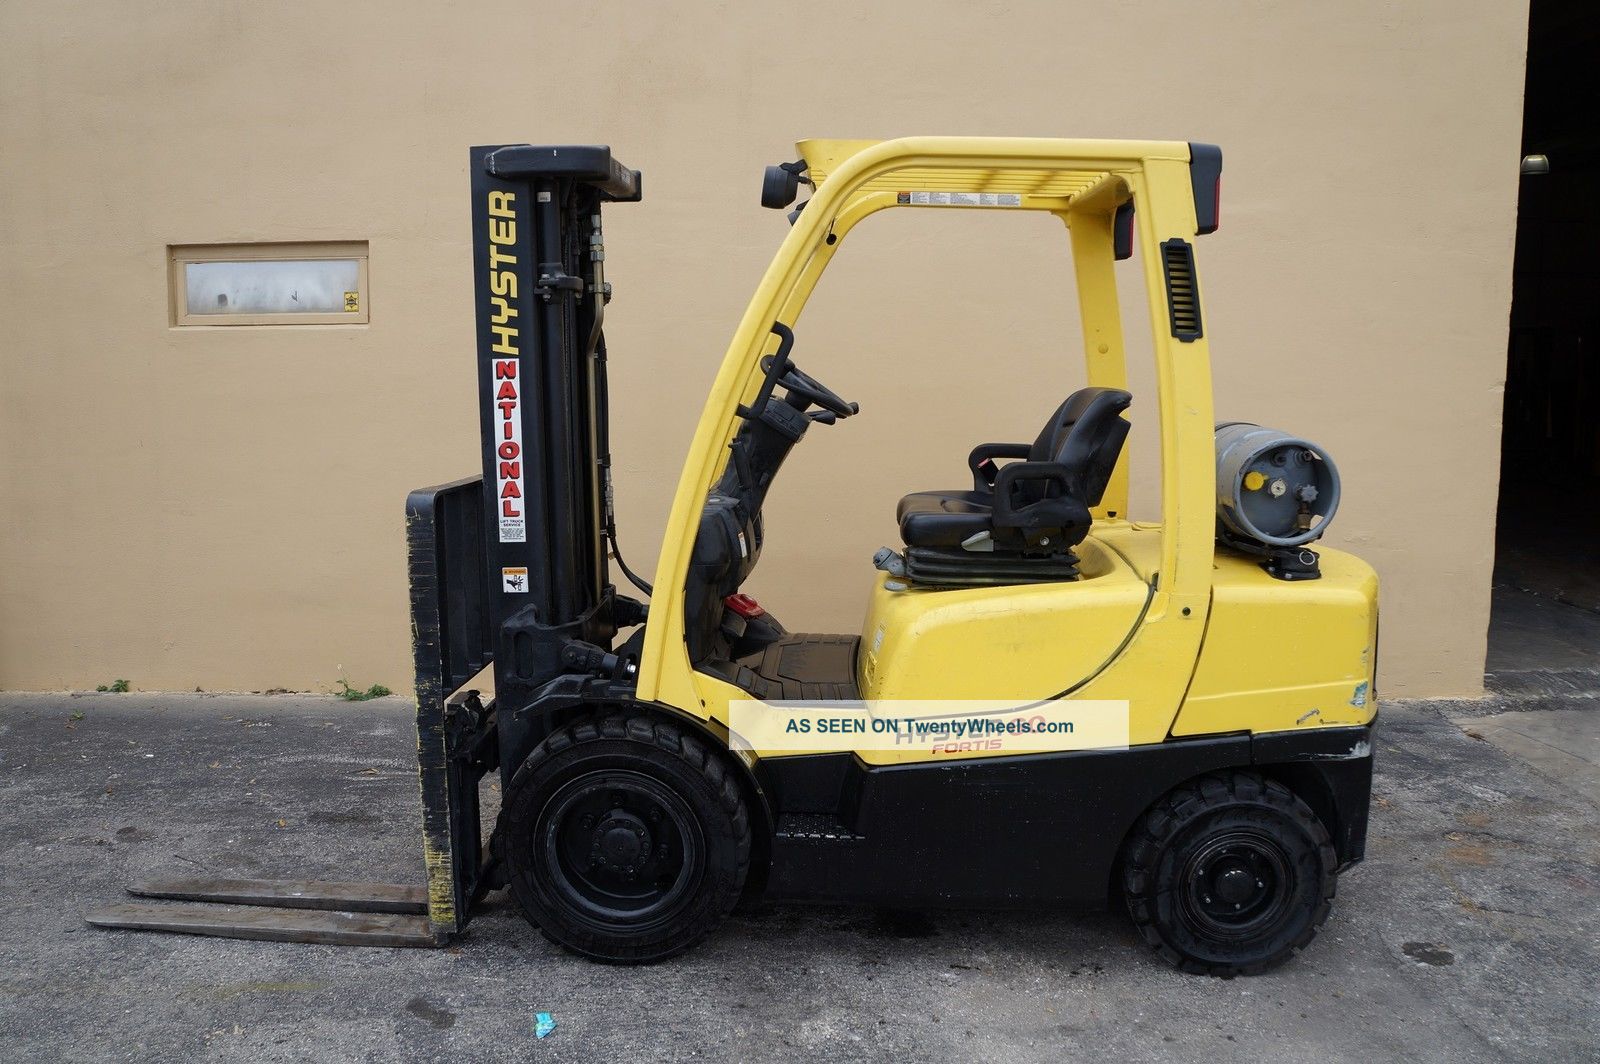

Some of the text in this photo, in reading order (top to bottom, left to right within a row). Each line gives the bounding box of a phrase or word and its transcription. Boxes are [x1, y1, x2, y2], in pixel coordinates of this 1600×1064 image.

[488, 190, 519, 355] HYSTER
[496, 361, 521, 517] NATIONAL
[932, 738, 1002, 754] FORTIS
